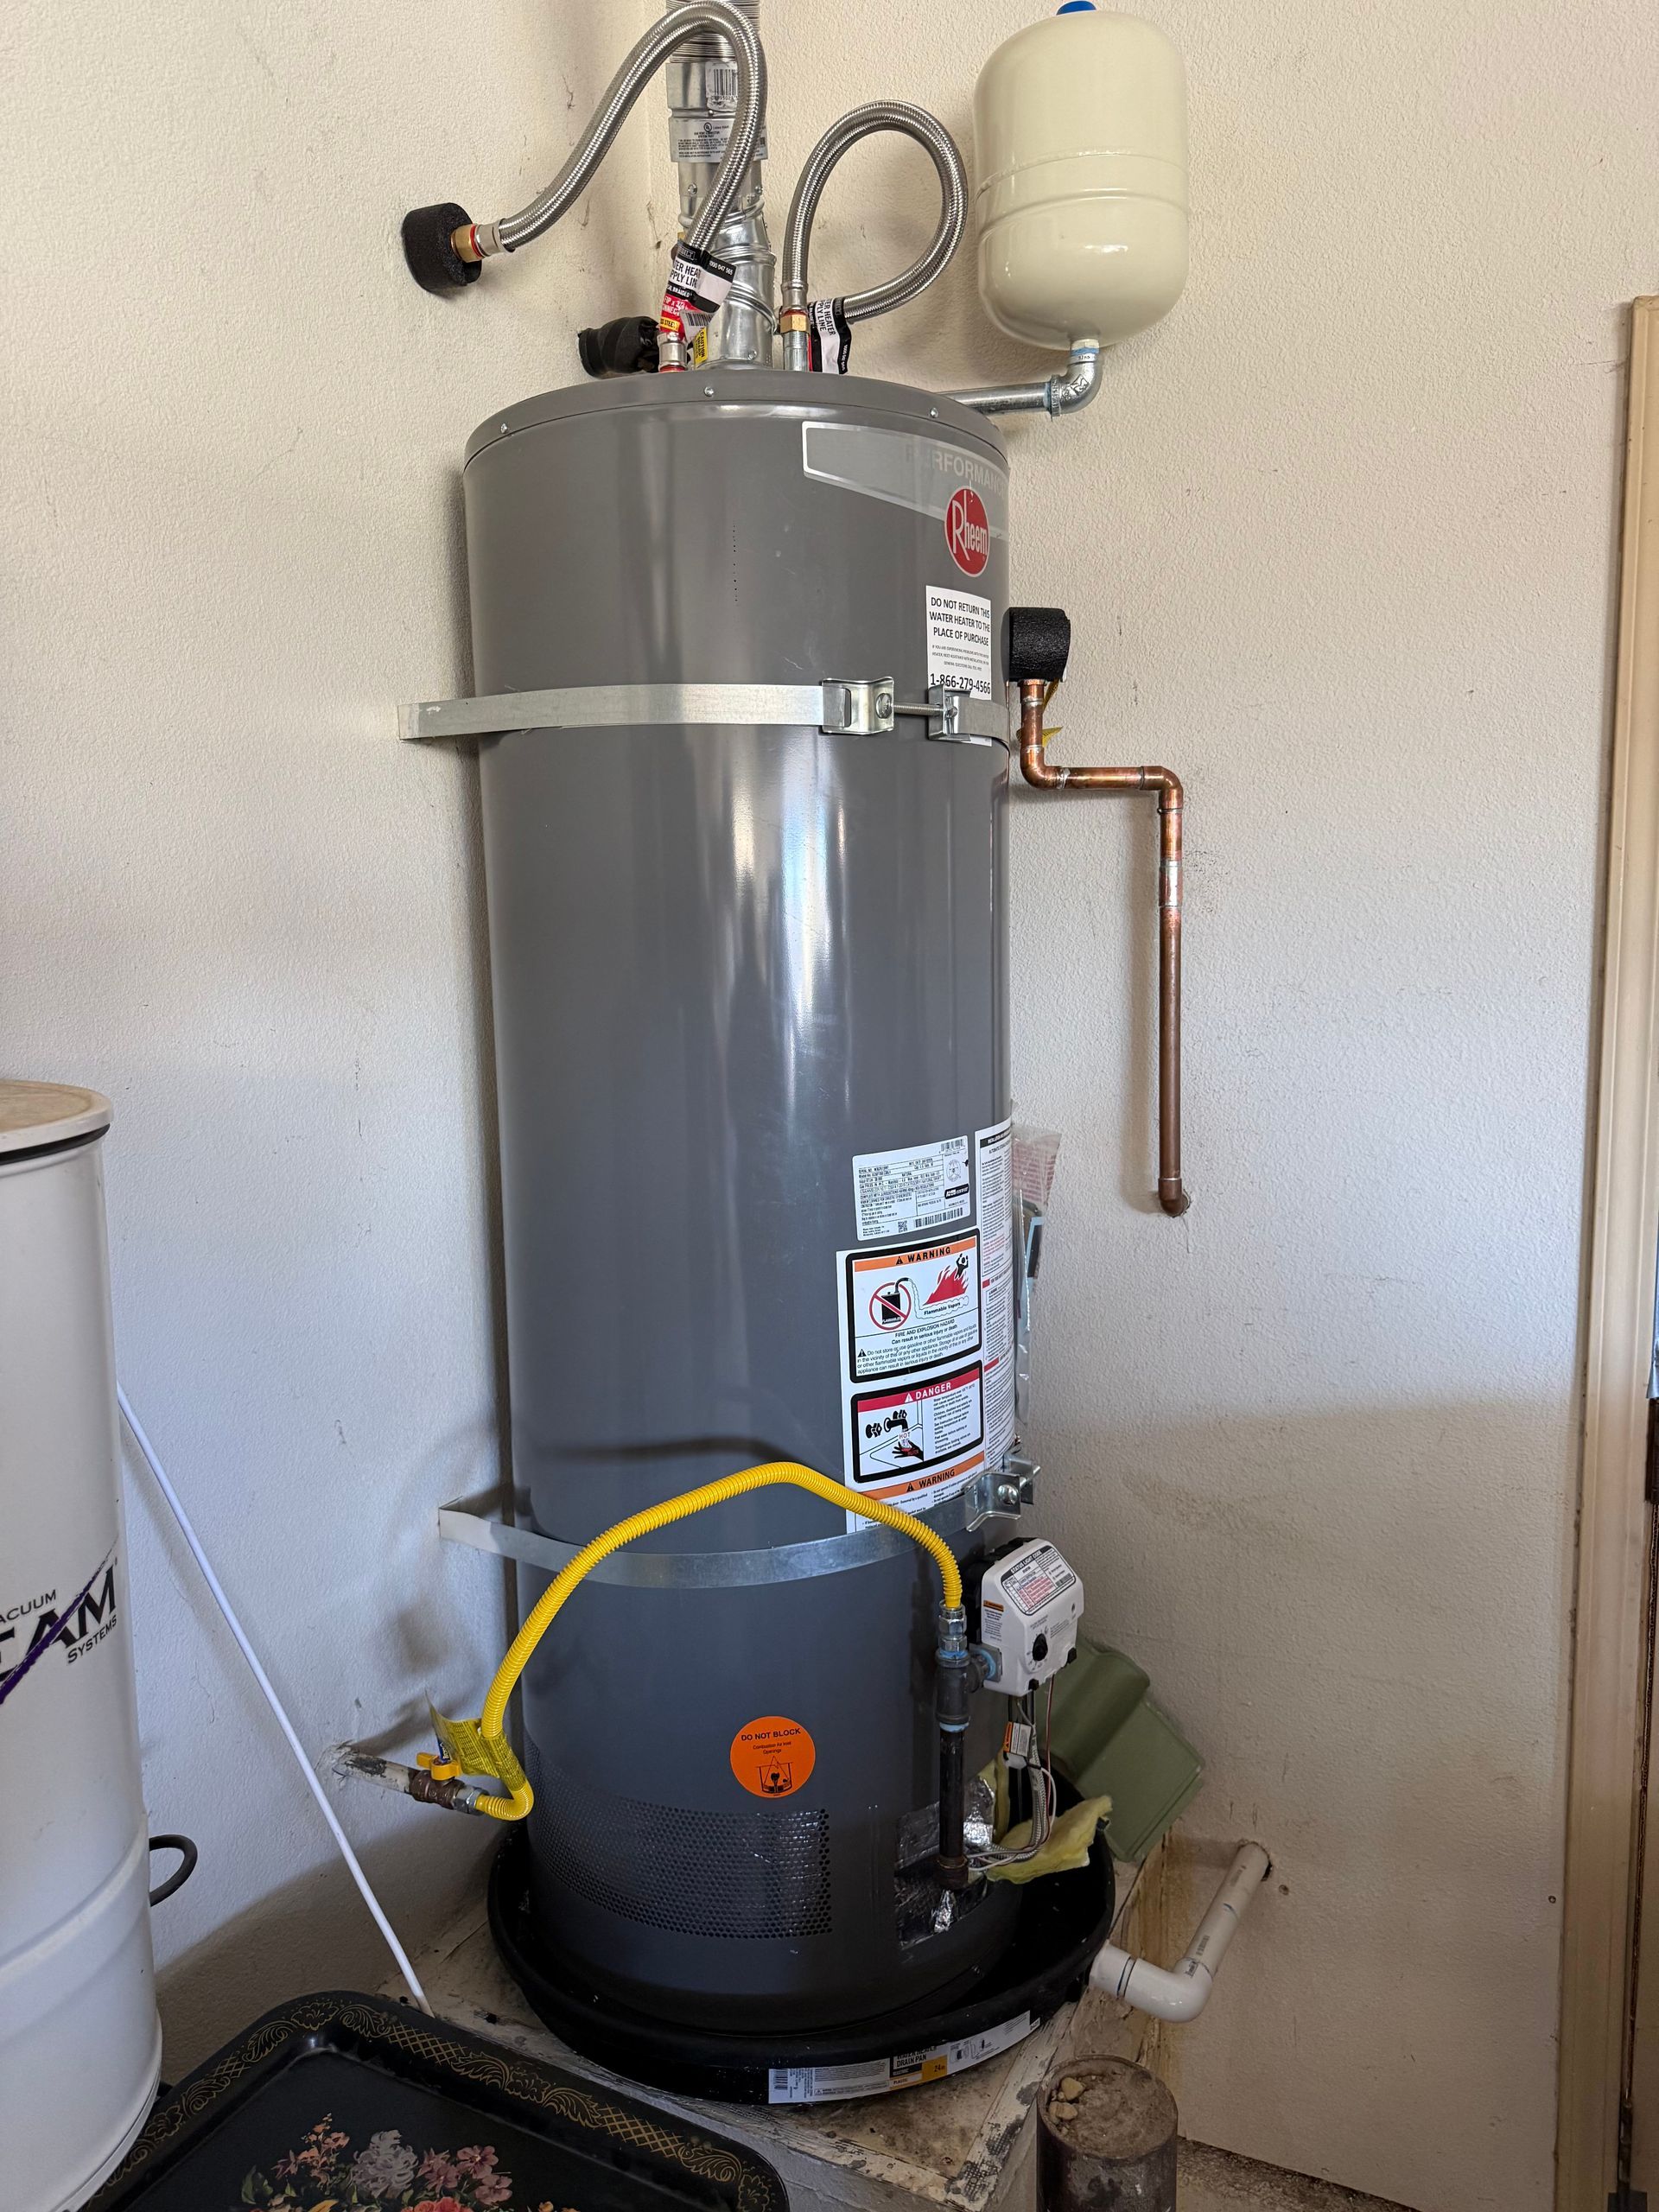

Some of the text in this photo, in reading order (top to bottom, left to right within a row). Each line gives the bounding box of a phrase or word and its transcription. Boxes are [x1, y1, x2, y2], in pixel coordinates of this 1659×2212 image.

[824, 311, 836, 335] HEATER
[951, 490, 988, 561] Rheem
[931, 596, 990, 619] DO NOT RETURN THIS
[930, 611, 953, 624] WATER
[954, 615, 975, 628] HEATER
[976, 620, 982, 630] TO
[933, 626, 988, 646] PLACE OF PURCHASE
[930, 673, 990, 695] 1-866-279-4566
[907, 1246, 951, 1262] WARNING
[924, 1306, 947, 1315] Flammable
[918, 1324, 939, 1332] EXPLOSION
[916, 1382, 951, 1400] DANGER
[919, 1469, 955, 1488] WARNING
[67, 1615, 117, 1664] SYSTEMS
[773, 1728, 801, 1738] BLOCK
[897, 2054, 927, 2067] DRAIN PAN
